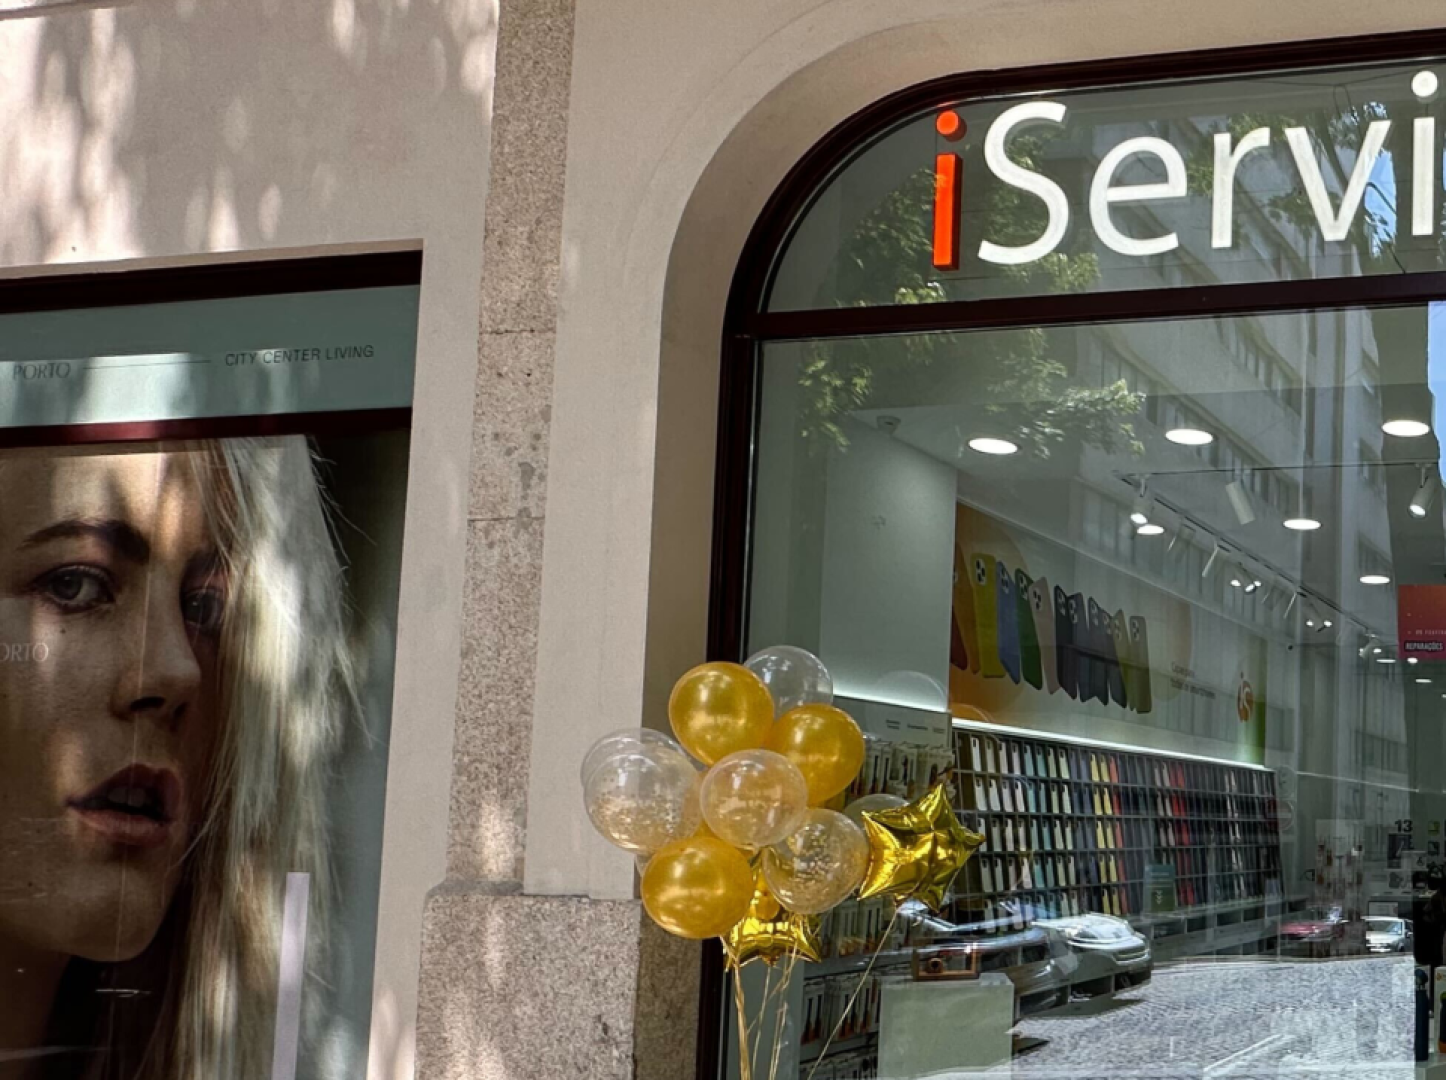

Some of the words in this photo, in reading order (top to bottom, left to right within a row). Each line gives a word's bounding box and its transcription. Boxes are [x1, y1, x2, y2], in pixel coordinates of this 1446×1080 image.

[12, 362, 71, 380] PORTO
[224, 352, 257, 367] CITY
[262, 347, 321, 364] CENTER
[325, 344, 375, 360] LIVING
